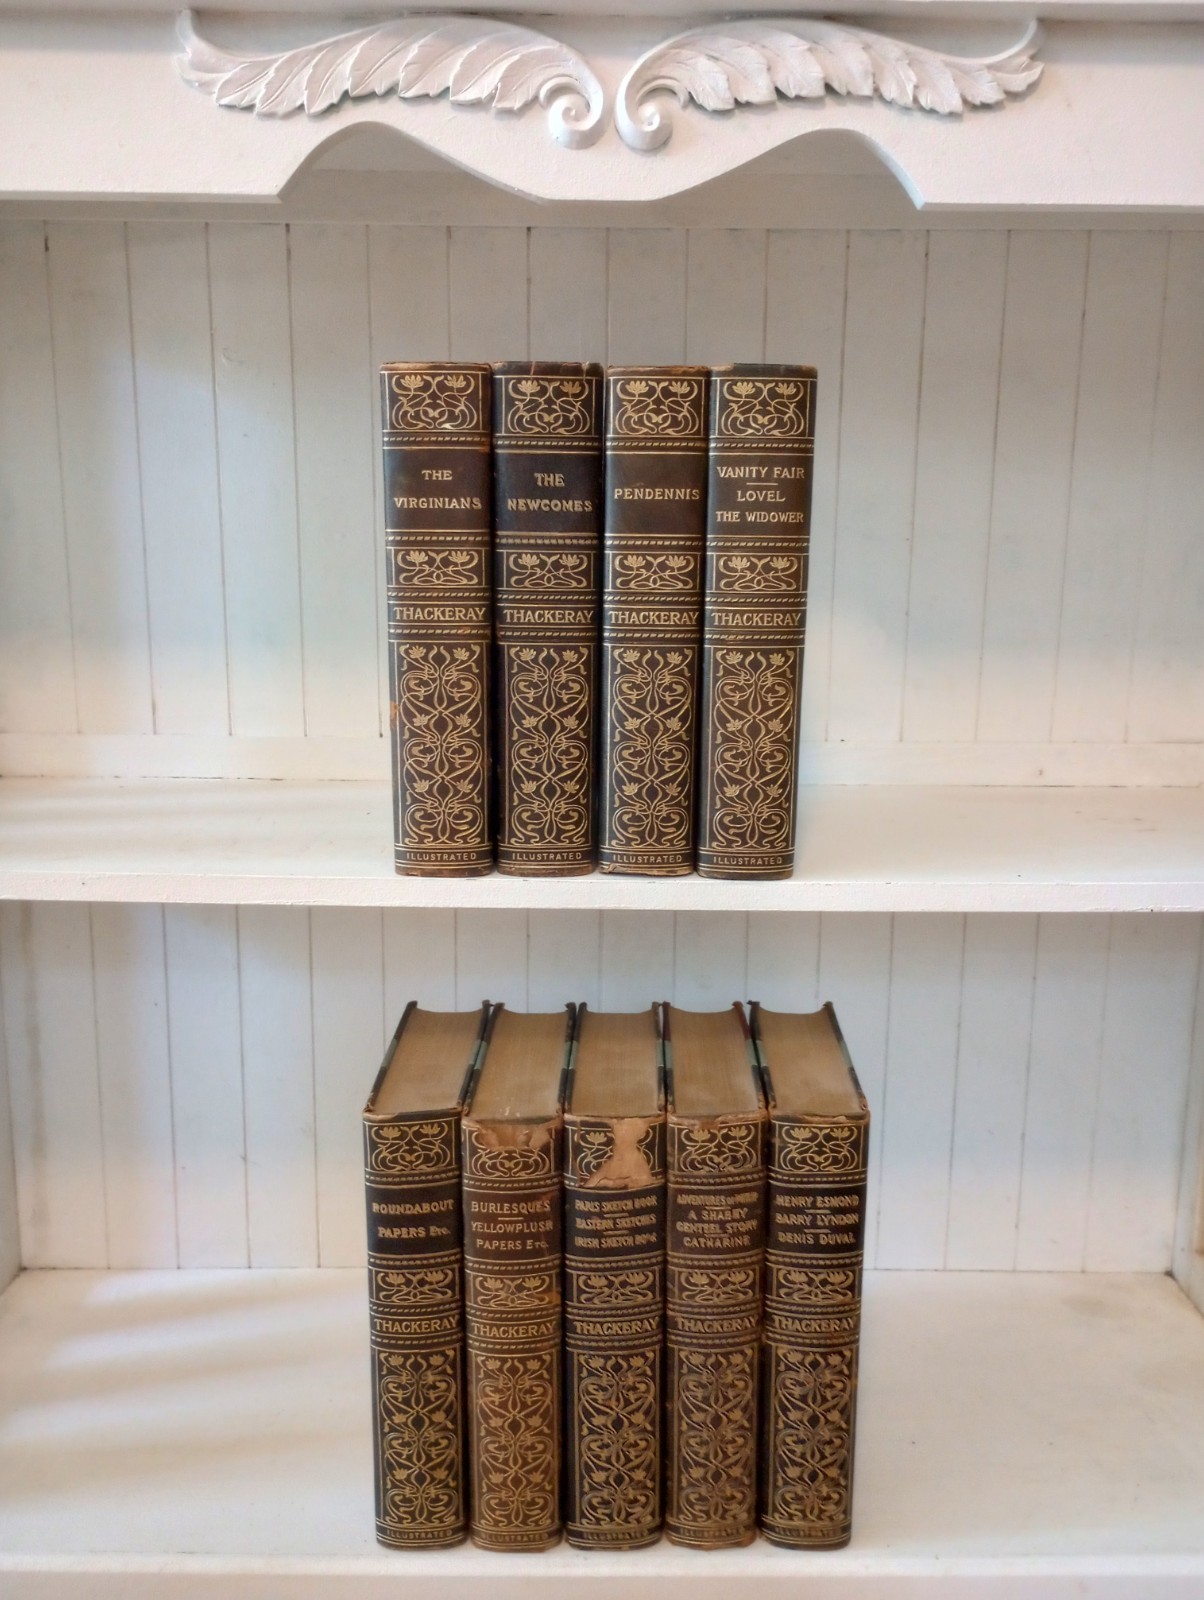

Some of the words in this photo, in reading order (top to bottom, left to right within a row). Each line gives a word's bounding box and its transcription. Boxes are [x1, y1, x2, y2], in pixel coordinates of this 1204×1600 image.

[421, 470, 453, 481] THE
[716, 466, 768, 479] VANITY
[773, 466, 805, 479] FAIR
[533, 472, 566, 488] THE
[614, 488, 700, 500] PENDENNIS
[736, 490, 786, 502] LOVEL
[393, 497, 482, 510] VIRGINIANS
[507, 498, 593, 512] NEWCOMES
[715, 511, 740, 522] THE
[745, 511, 804, 523] WIDOWER
[393, 607, 486, 621] THACKERAY
[503, 609, 594, 624] THACKERAY
[608, 611, 699, 625] THACKERAY
[711, 612, 802, 626] THACKERAY
[406, 852, 477, 861] ILLUSTRATED
[512, 852, 582, 861] ILLUSTRATED
[612, 855, 682, 864] ILLUSTRATED
[713, 856, 783, 865] ILLUSTRATED
[372, 1199, 455, 1215] ROUNDABOUT
[471, 1200, 551, 1214] BURLESQUES
[775, 1194, 813, 1208] HENRY
[687, 1210, 698, 1220] A
[775, 1212, 813, 1226] BARRY
[378, 1226, 426, 1239] PAPERS
[778, 1231, 815, 1245] DENIS
[819, 1231, 856, 1245] DUVAL
[476, 1239, 522, 1250] PAPERS
[374, 1316, 460, 1333] THACKERAY
[472, 1321, 557, 1338] THACKERAY
[573, 1317, 659, 1334] THACKERAY
[675, 1314, 758, 1333] THACKERAY
[772, 1314, 856, 1333] THACKERAY
[386, 1529, 453, 1540] ILLUSTRATED
[481, 1532, 548, 1542] ILLUSTRATED
